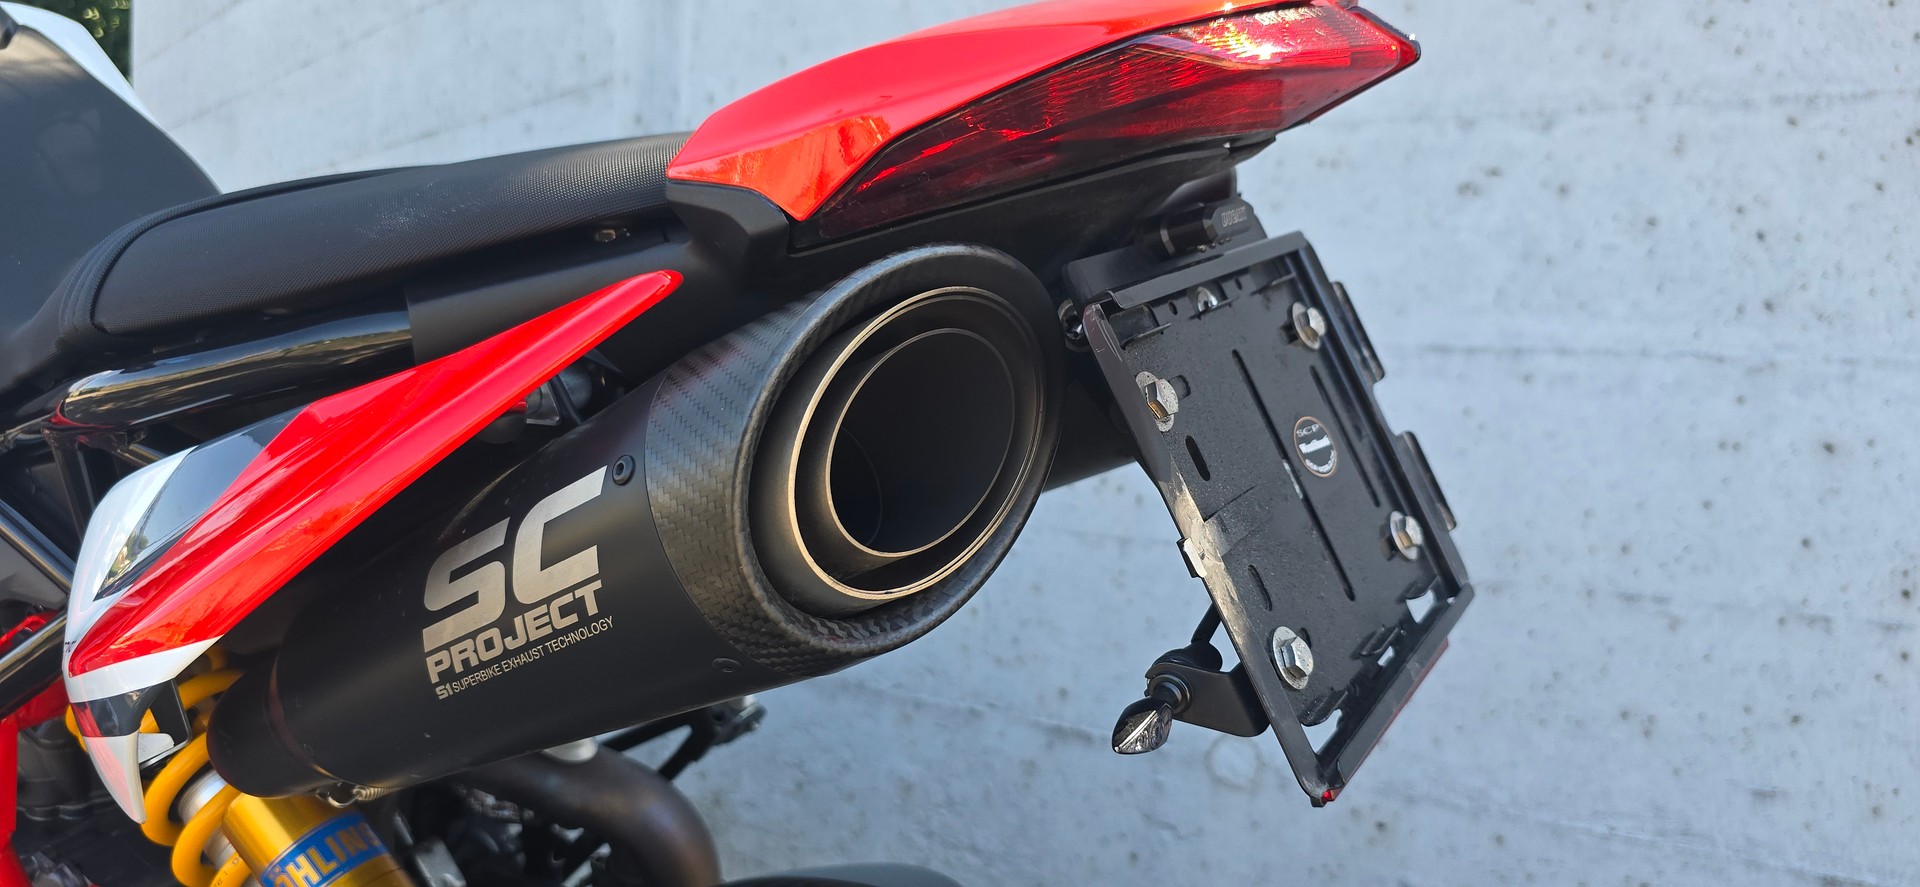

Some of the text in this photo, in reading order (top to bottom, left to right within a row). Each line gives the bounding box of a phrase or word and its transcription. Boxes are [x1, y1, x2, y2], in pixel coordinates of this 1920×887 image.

[423, 465, 608, 653] SC
[426, 579, 603, 684] PROJECT
[435, 615, 614, 700] S1 SUPERBIKE EXHAUST TECHNOLOGY
